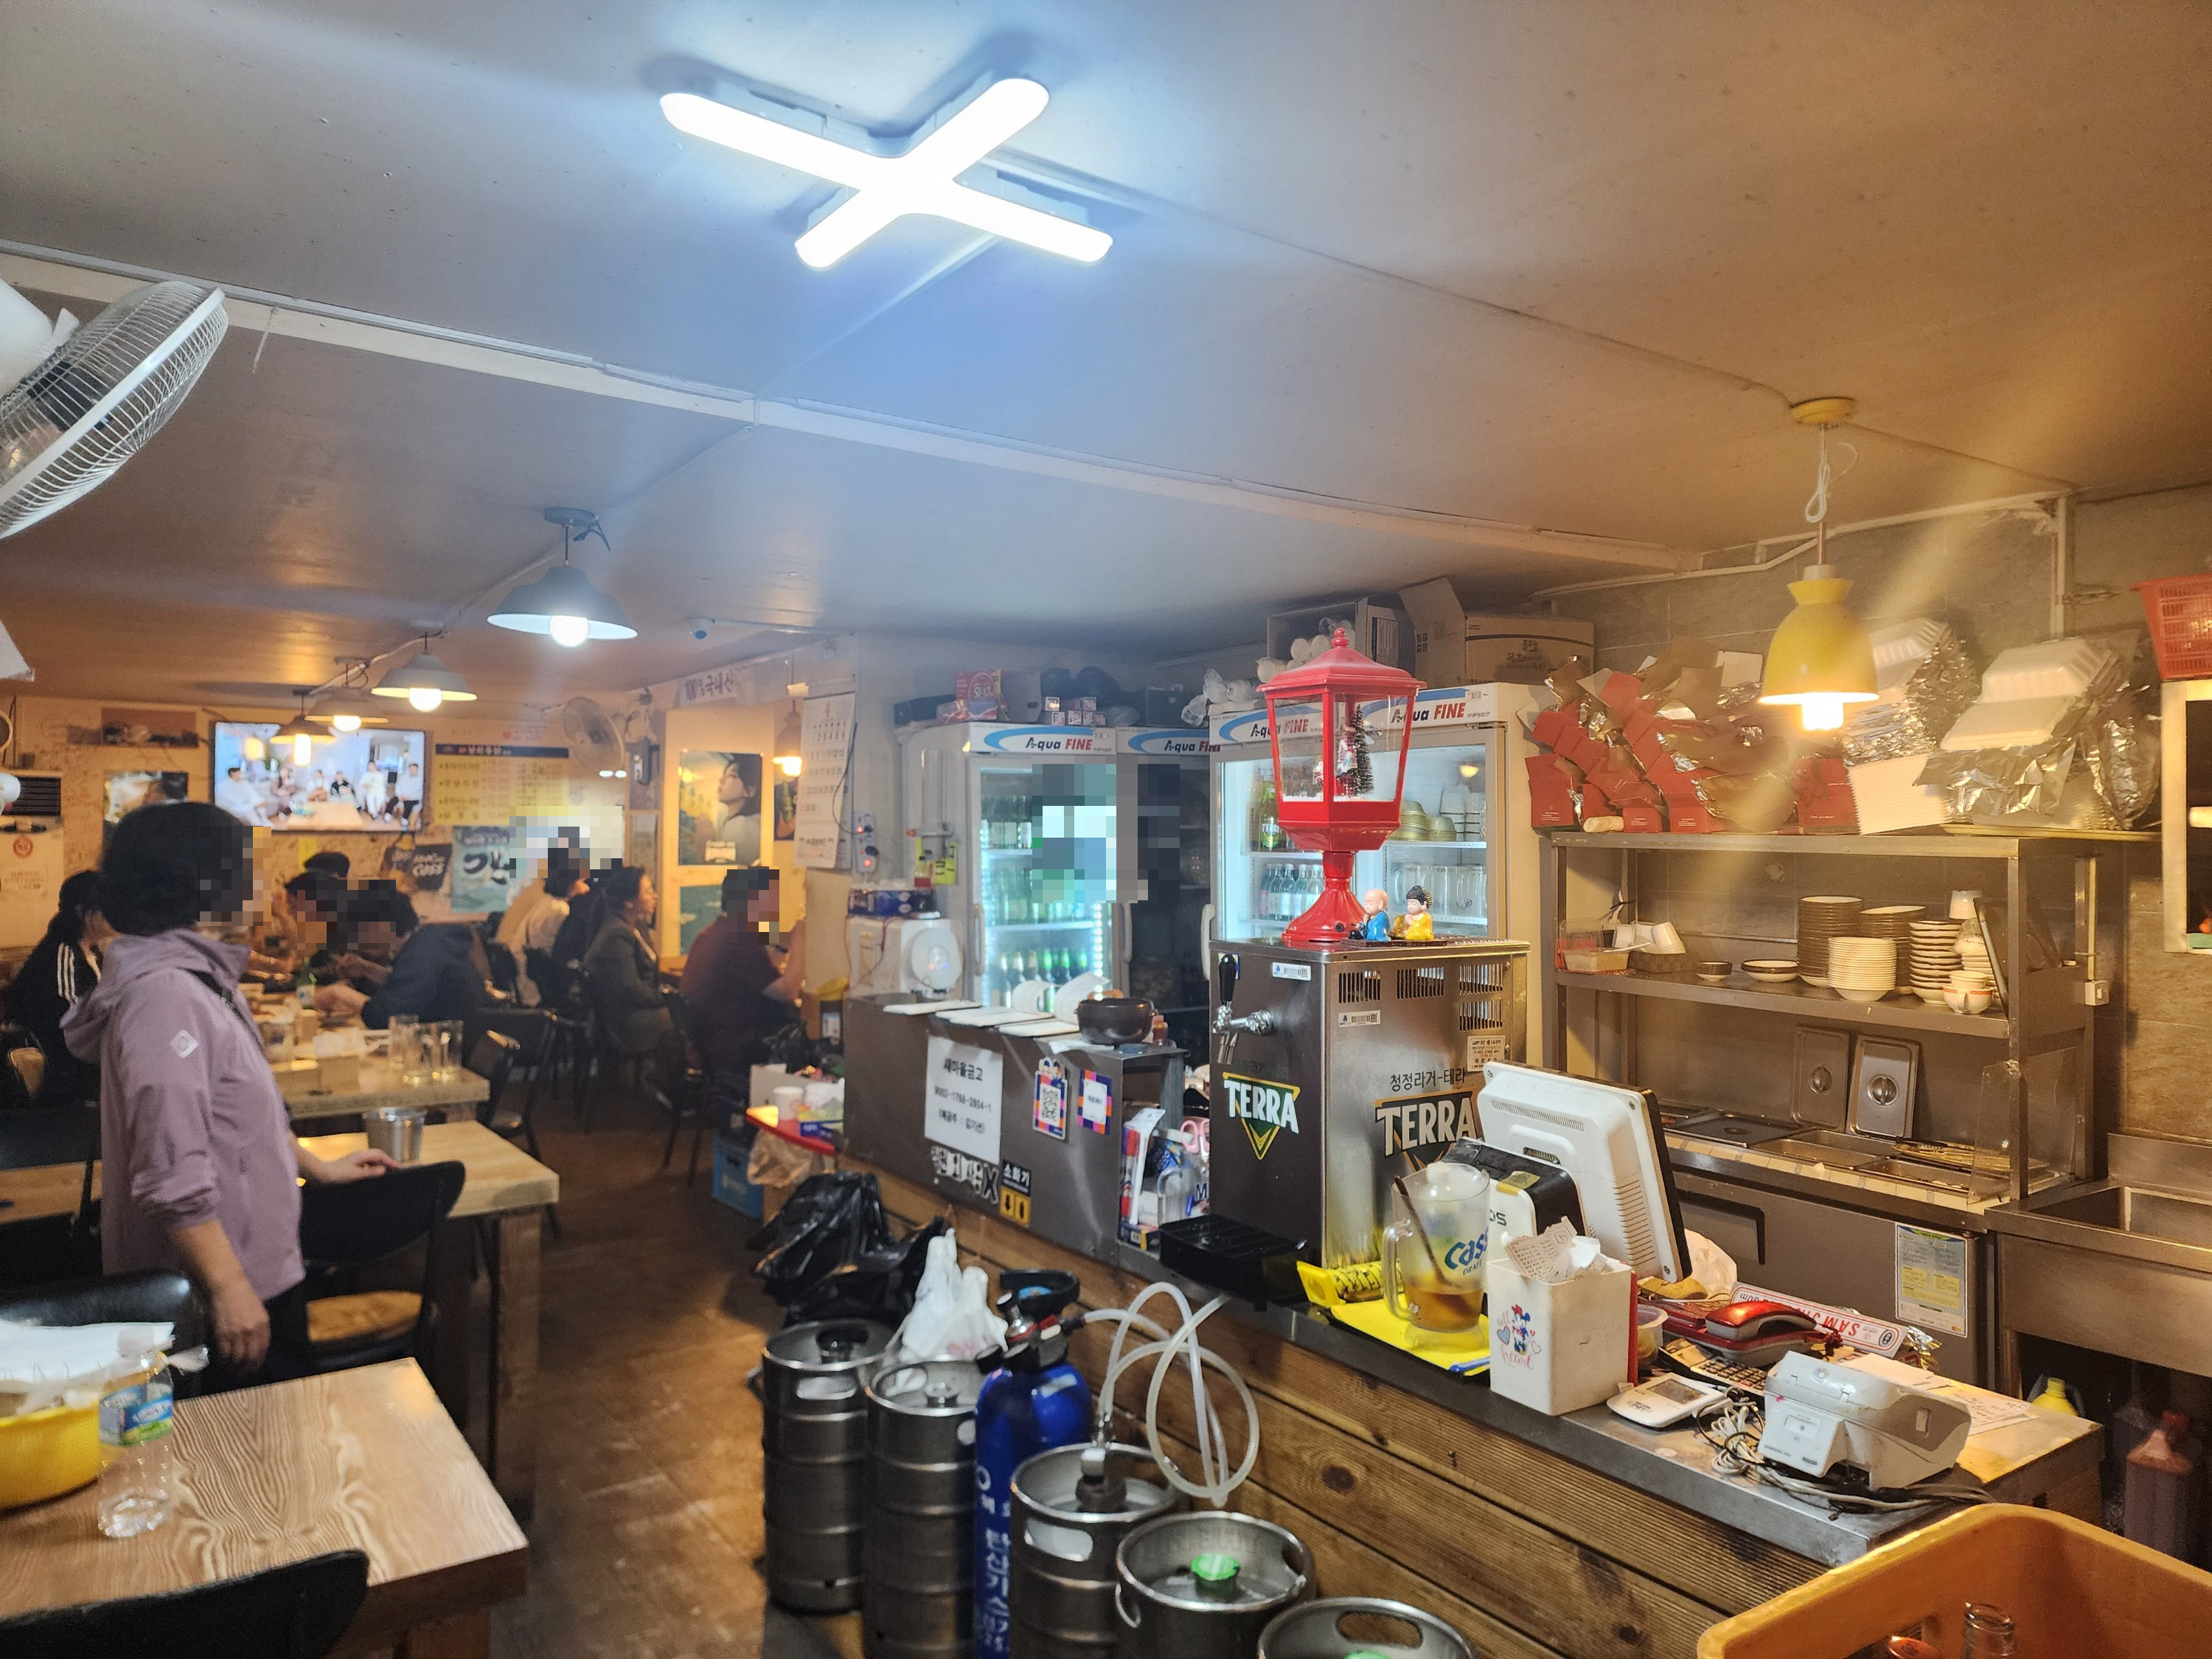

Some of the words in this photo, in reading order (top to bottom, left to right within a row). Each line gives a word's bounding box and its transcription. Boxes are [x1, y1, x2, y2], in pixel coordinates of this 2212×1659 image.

[1391, 708, 1430, 723] Aua
[1433, 702, 1467, 720] FINE
[1284, 719, 1310, 734] FINE
[1025, 737, 1061, 751] Aqua
[1065, 738, 1093, 751] FINE
[1164, 740, 1195, 752] Aqua
[944, 1057, 984, 1082] 새마을금고
[1390, 1067, 1467, 1092] 청정라거-테라
[1224, 1079, 1299, 1134] TERRA
[1377, 1096, 1478, 1157] TERRA
[1003, 1163, 1030, 1186] 소화기
[1823, 1315, 1860, 1337] SAM
